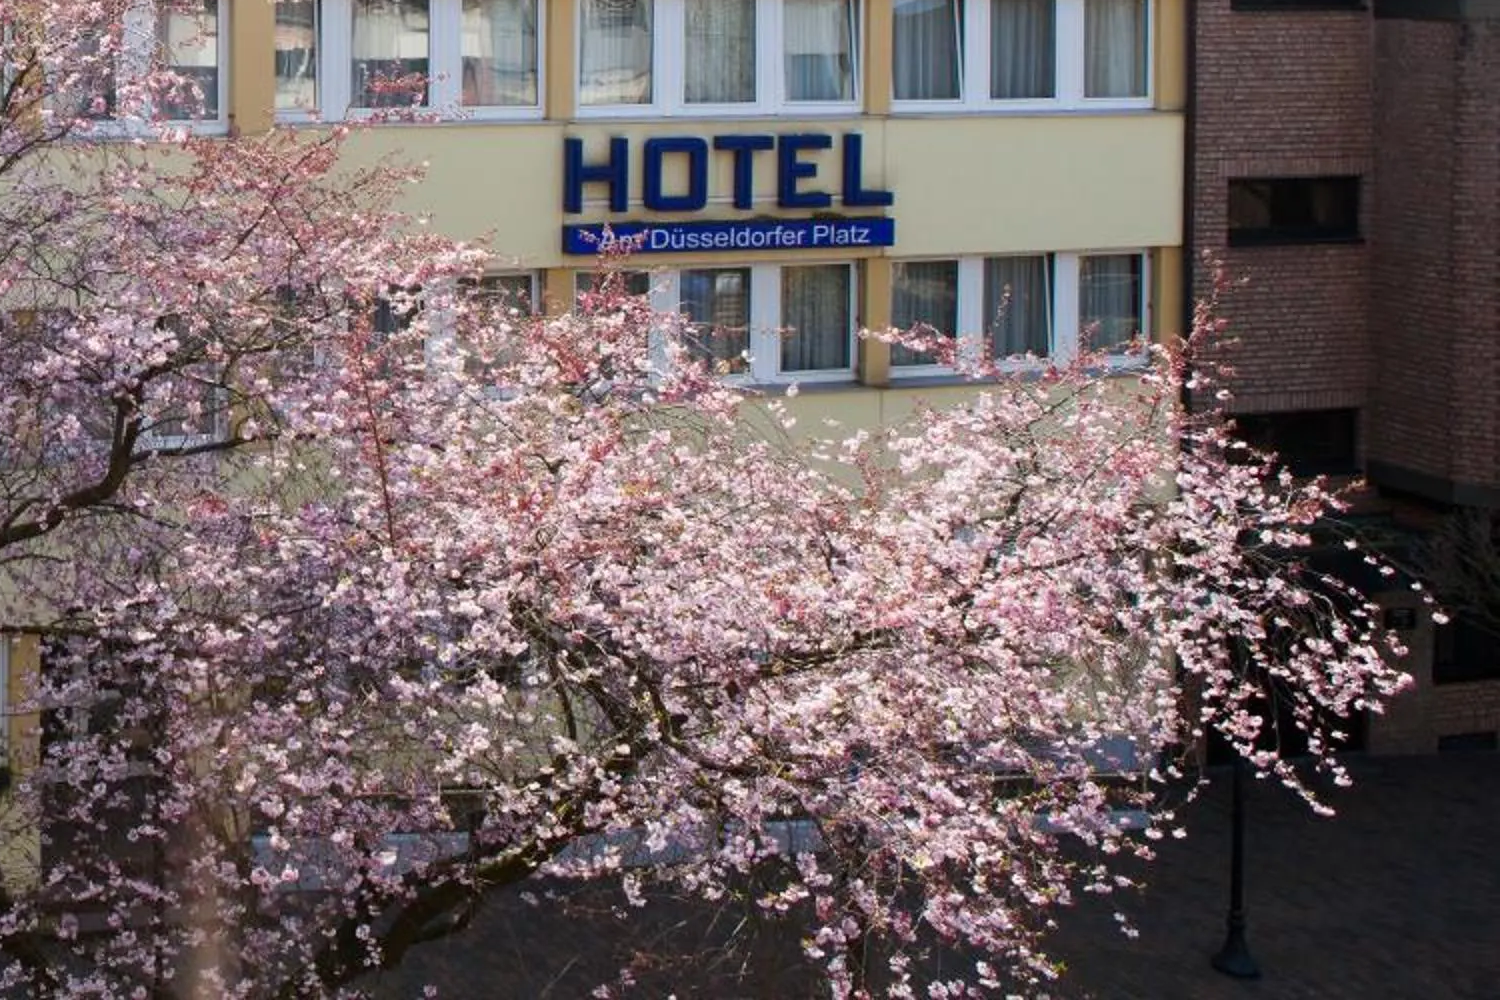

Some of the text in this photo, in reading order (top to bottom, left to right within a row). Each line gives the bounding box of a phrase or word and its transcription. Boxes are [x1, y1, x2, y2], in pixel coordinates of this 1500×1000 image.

[563, 133, 894, 214] HOTEL
[651, 225, 806, 249] Düsseldorfer
[812, 224, 871, 245] Platz
